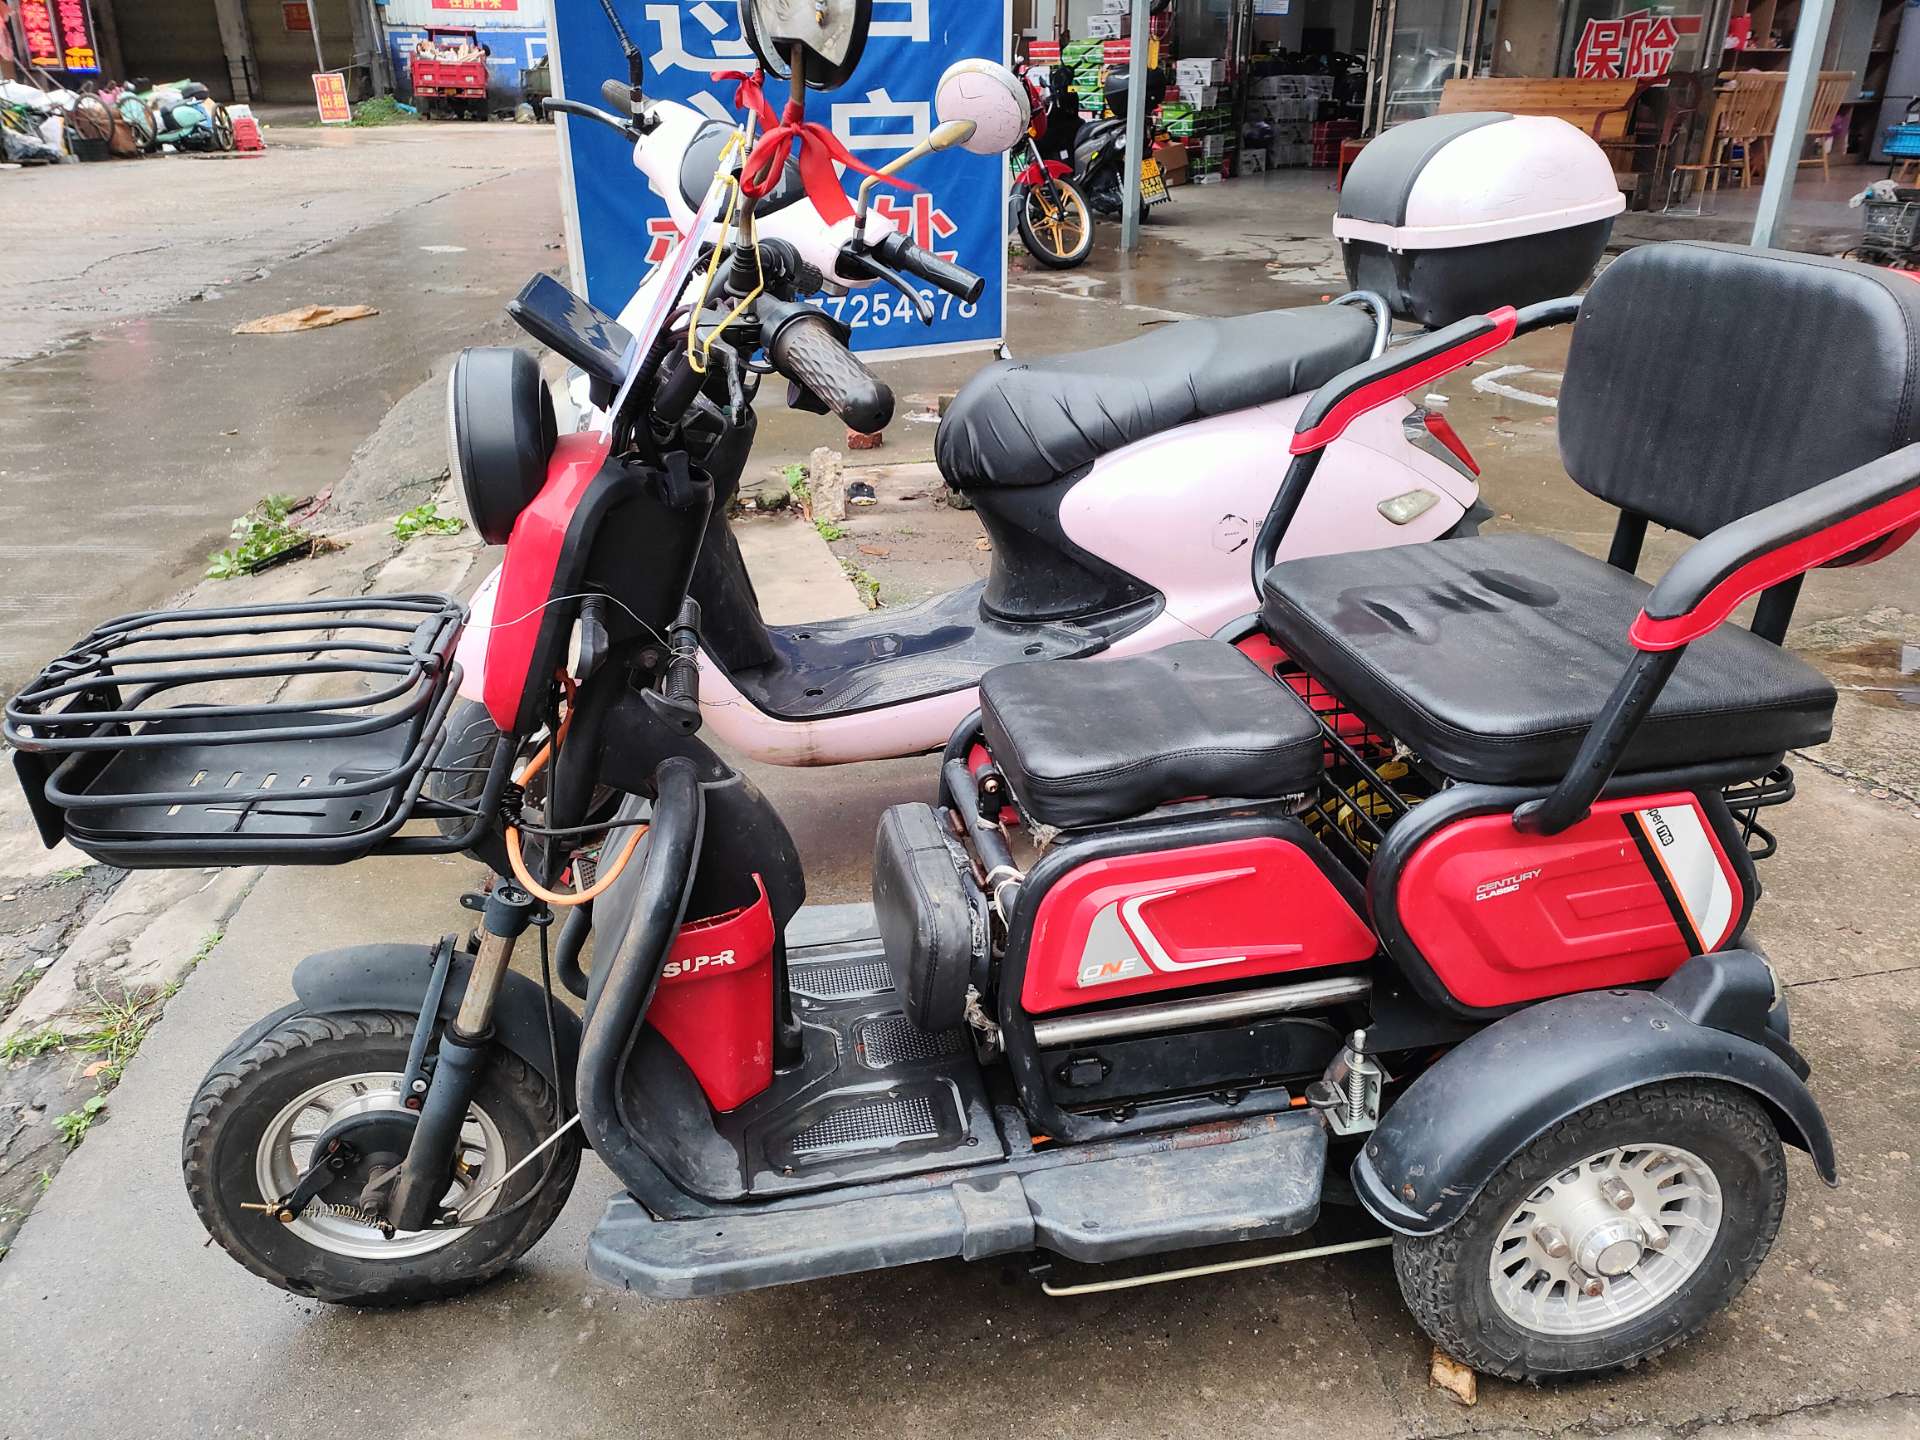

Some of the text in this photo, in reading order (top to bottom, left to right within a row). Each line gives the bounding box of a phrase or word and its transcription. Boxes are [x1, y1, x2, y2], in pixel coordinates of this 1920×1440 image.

[1574, 16, 1680, 87] 保险
[321, 94, 347, 109] 出租
[1476, 868, 1542, 893] CENTURY
[1475, 884, 1520, 902] CLASSIC
[662, 949, 736, 978] SUPER
[1084, 956, 1139, 979] ONE
